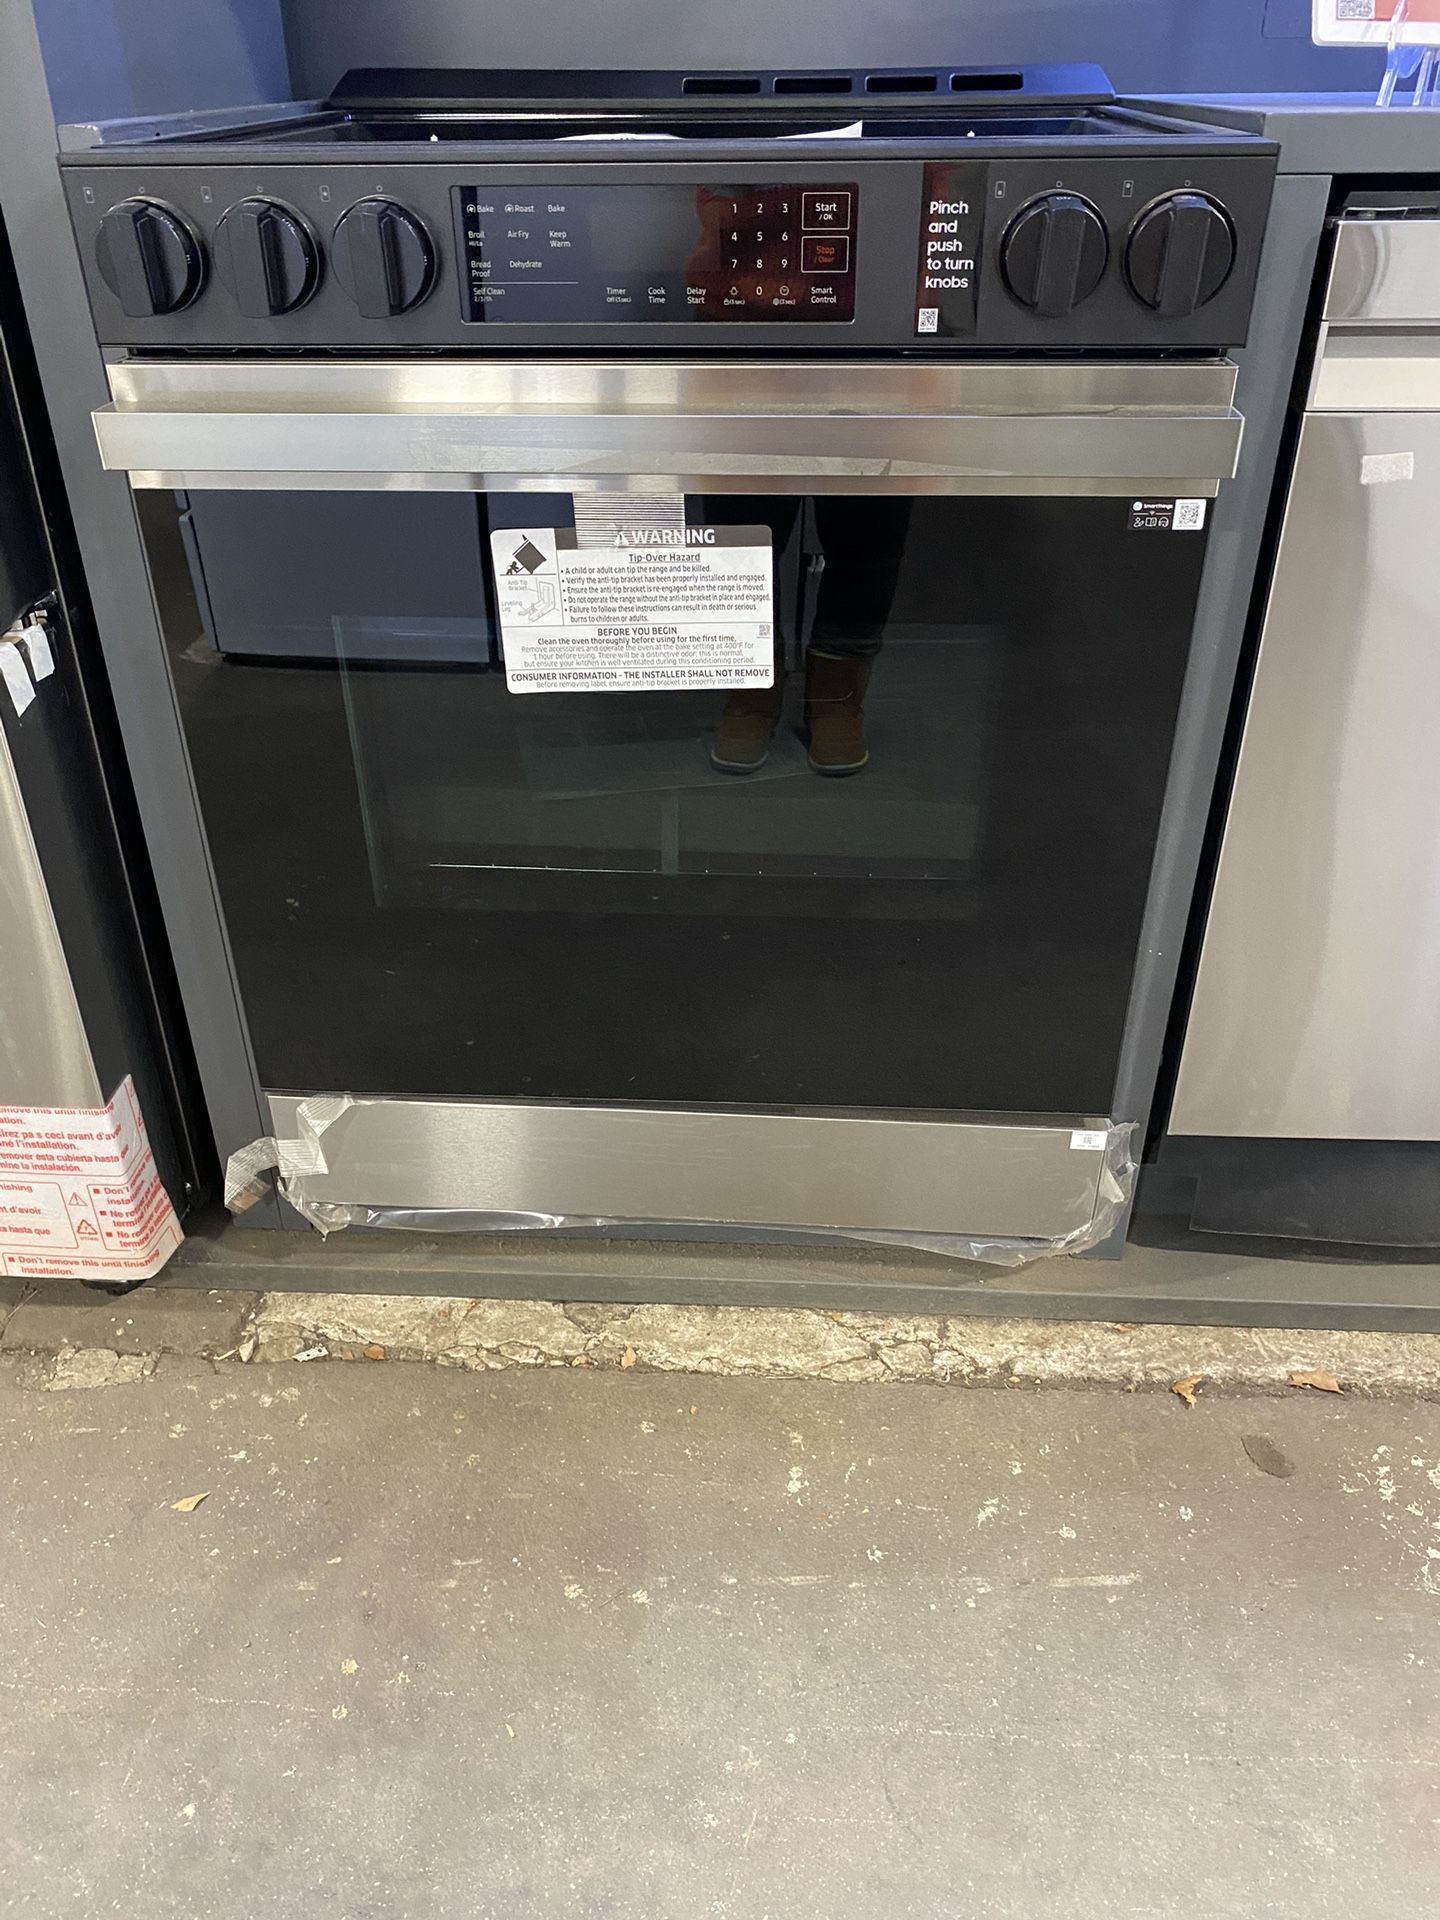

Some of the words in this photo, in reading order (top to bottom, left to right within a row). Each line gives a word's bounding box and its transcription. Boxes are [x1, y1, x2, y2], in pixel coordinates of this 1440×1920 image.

[477, 204, 494, 213] Bake
[515, 204, 535, 213] Roast
[548, 204, 565, 213] Bake
[732, 204, 737, 213] 1
[757, 204, 763, 213] 2
[782, 204, 788, 213] 3
[816, 203, 837, 211] Start
[930, 200, 968, 214] Pinch
[928, 220, 958, 233] and
[468, 230, 485, 239] Broil
[508, 230, 518, 238] Air
[518, 230, 529, 240] Fry
[549, 230, 567, 239] Keep
[732, 232, 738, 241] 4
[757, 232, 763, 241] 5
[782, 232, 788, 241] 6
[550, 240, 571, 248] Warm
[927, 239, 962, 256] push
[816, 246, 835, 255] Stop
[471, 260, 491, 268] Bread
[510, 260, 542, 269] Dehydrate
[732, 259, 737, 268] 7
[757, 259, 763, 268] 8
[781, 259, 788, 268] 9
[926, 259, 942, 270] to
[945, 258, 974, 270] turn
[925, 276, 968, 289] knobs
[648, 287, 666, 295] Cook
[687, 287, 706, 296] Delay
[756, 286, 762, 295] 0
[811, 286, 832, 294] Smart
[648, 296, 666, 304] Time
[687, 296, 705, 304] Start
[811, 296, 836, 304] Control
[632, 529, 715, 544] WARNING
[629, 554, 667, 564] Tip-Over
[669, 554, 701, 563] Hazard
[566, 577, 585, 585] Verify
[597, 628, 630, 636] BEFORE
[632, 627, 650, 635] YOU
[651, 627, 677, 635] BEGIN
[511, 673, 557, 681] CONSUMER
[624, 671, 640, 679] THE
[734, 669, 769, 677] REMOVE
[22, 1131, 34, 1140] pa
[45, 1131, 65, 1140] ceci
[36, 1153, 54, 1161] esta
[57, 1154, 93, 1162] cubierta
[21, 1162, 30, 1170] la
[104, 1187, 130, 1195] Don't
[9, 1226, 33, 1234] hasta
[34, 1228, 51, 1236] que
[18, 1256, 43, 1264] Don't
[102, 1260, 122, 1268] until
